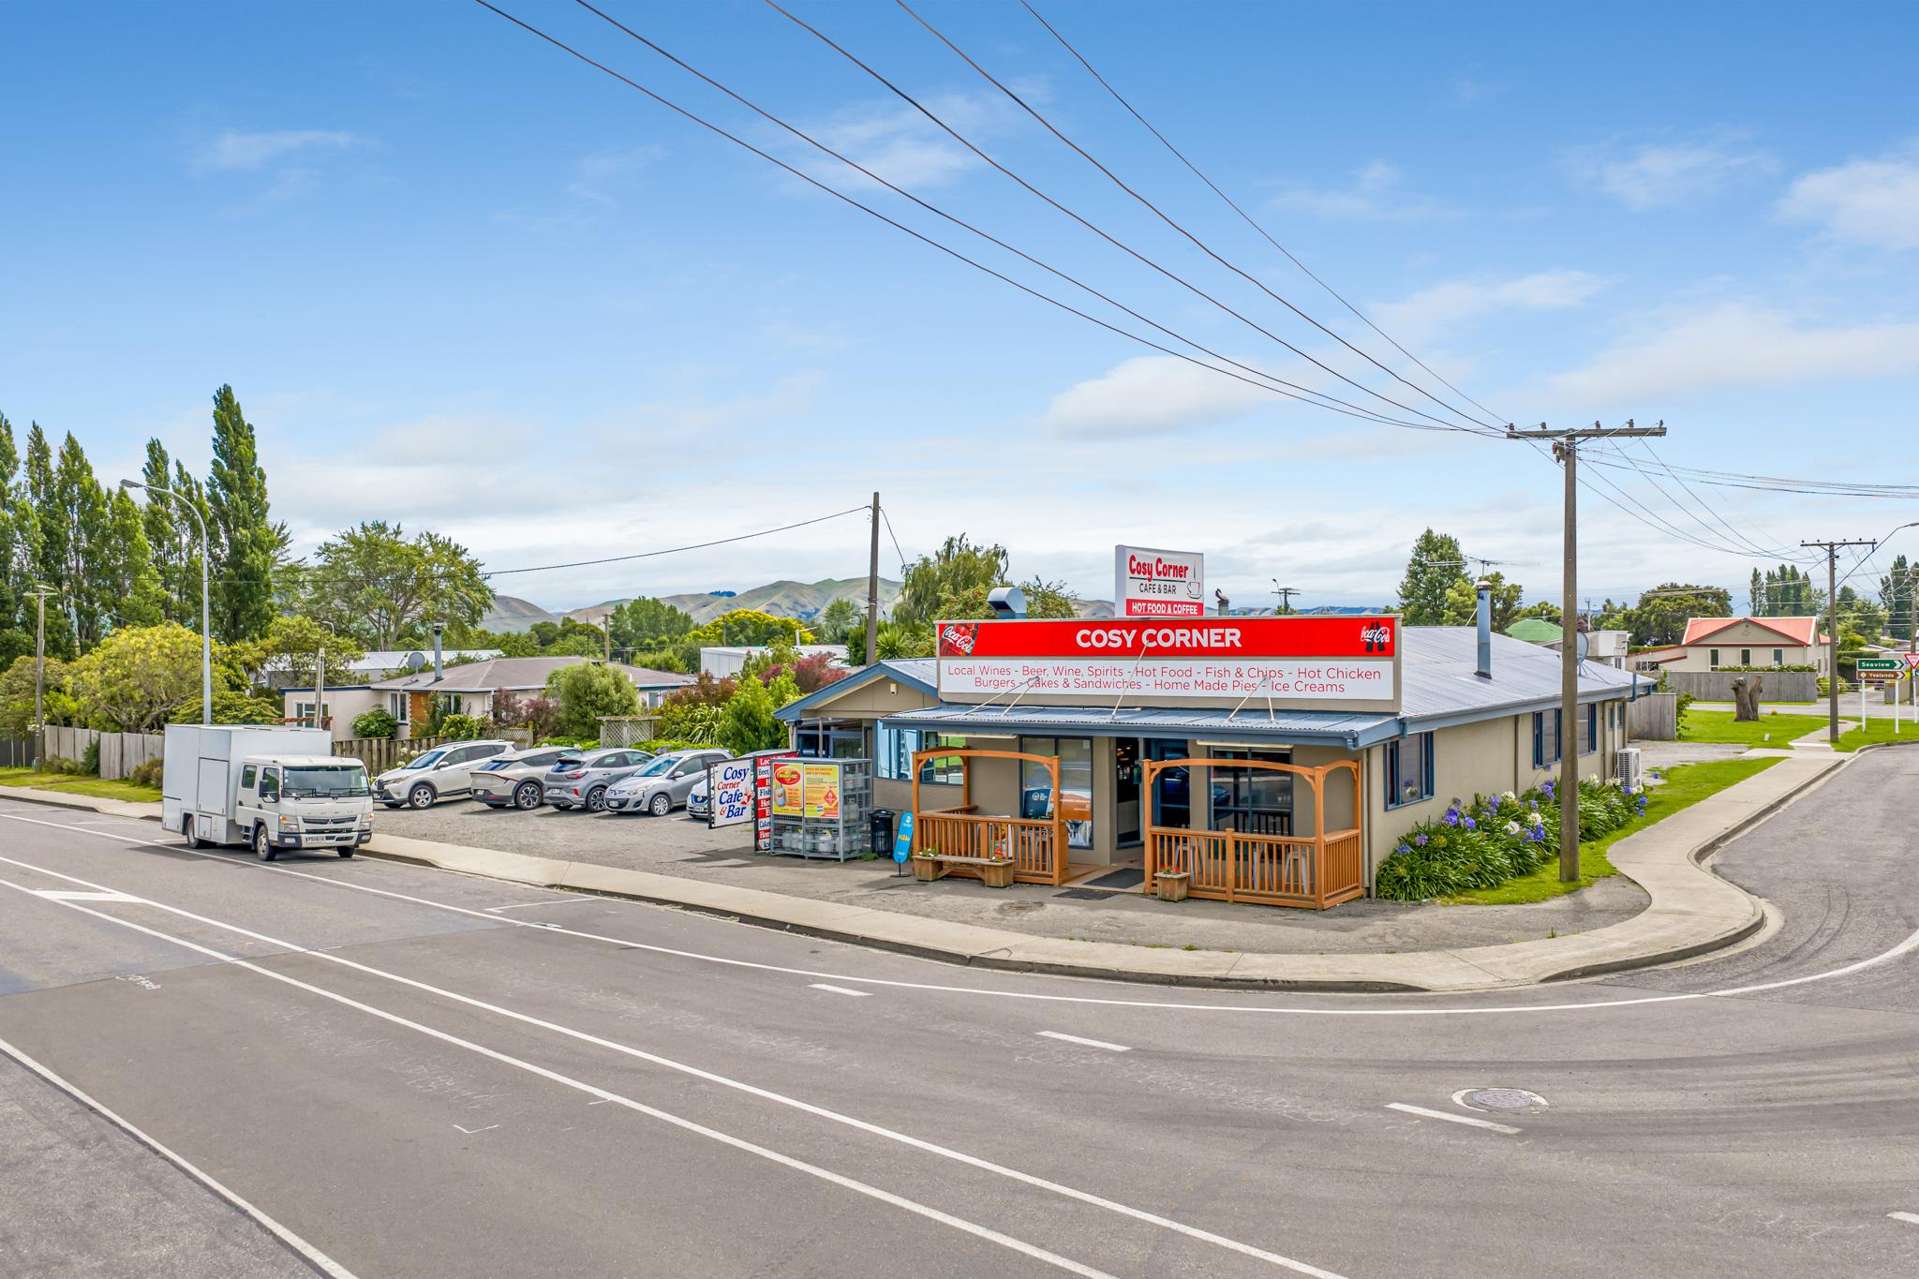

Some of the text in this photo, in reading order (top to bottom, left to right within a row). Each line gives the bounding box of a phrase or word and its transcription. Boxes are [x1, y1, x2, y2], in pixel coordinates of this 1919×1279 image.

[1129, 554, 1188, 582] Cosy Corner
[1139, 583, 1177, 594] CAFE & BAR
[1132, 601, 1198, 614] HOT FOOD & COFFEE
[1076, 628, 1242, 648] COSY CORNER
[948, 665, 975, 675] Local
[979, 665, 1011, 675] Wines
[1022, 665, 1050, 677] Beer,
[1053, 666, 1084, 677] Wine,
[1088, 665, 1123, 677] Spirits
[1136, 666, 1156, 677] Hot
[1161, 666, 1192, 677] Food
[1205, 666, 1231, 678] Fish
[1235, 667, 1245, 678] &
[1248, 667, 1284, 681] Chips
[1298, 667, 1321, 679] Hot
[1327, 667, 1381, 679] Chicken
[975, 677, 1016, 689] Burgers
[1027, 678, 1059, 688] Cakes
[1062, 678, 1070, 688] &
[1074, 678, 1142, 690] Sandwiches
[1154, 680, 1190, 690] Home
[1195, 680, 1227, 690] Made
[1232, 680, 1257, 691] Pies
[1272, 681, 1289, 692] Ice
[1295, 681, 1345, 692] Creams
[723, 766, 750, 782] Cosy
[717, 781, 740, 791] Corner
[719, 789, 743, 805] Cafe
[720, 804, 747, 818] & Bar
